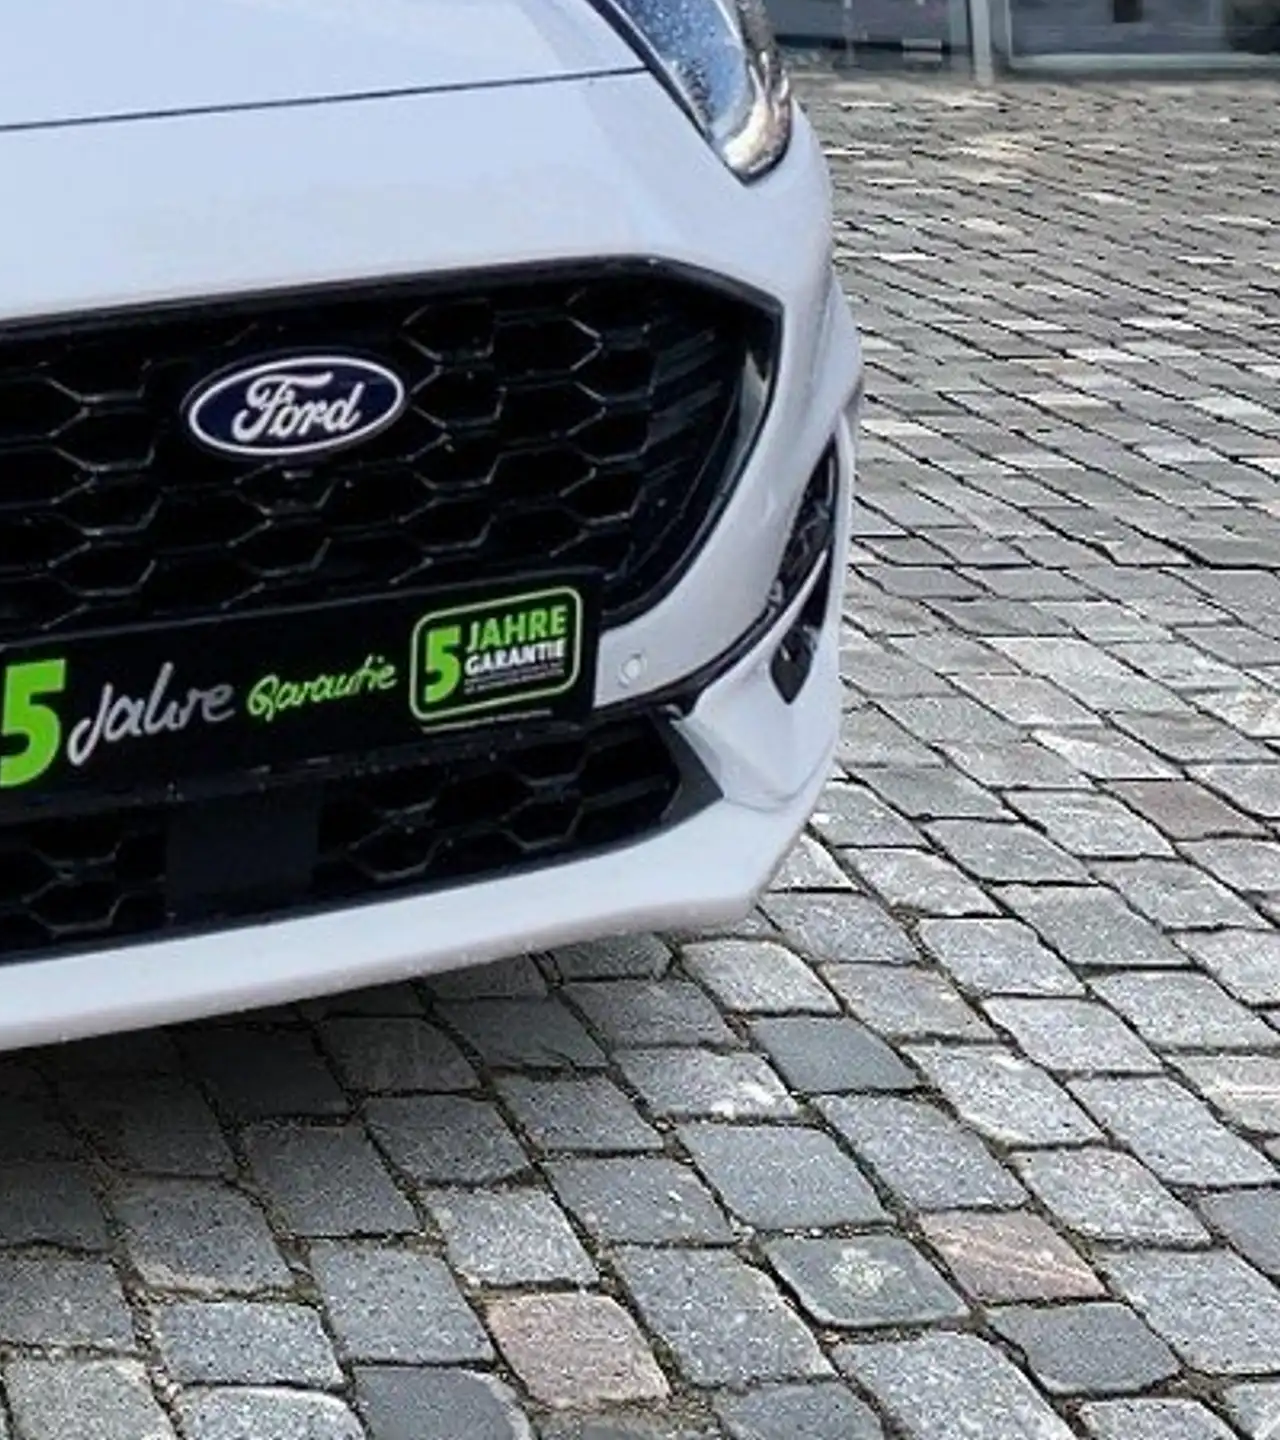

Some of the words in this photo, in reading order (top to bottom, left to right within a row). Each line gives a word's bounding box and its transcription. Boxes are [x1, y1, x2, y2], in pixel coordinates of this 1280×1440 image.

[231, 371, 365, 442] Ford
[424, 624, 462, 704] 5
[465, 604, 569, 653] JAHRE
[464, 638, 566, 677] GARANTIE
[67, 662, 236, 767] Jahre
[246, 652, 398, 722] Garantie
